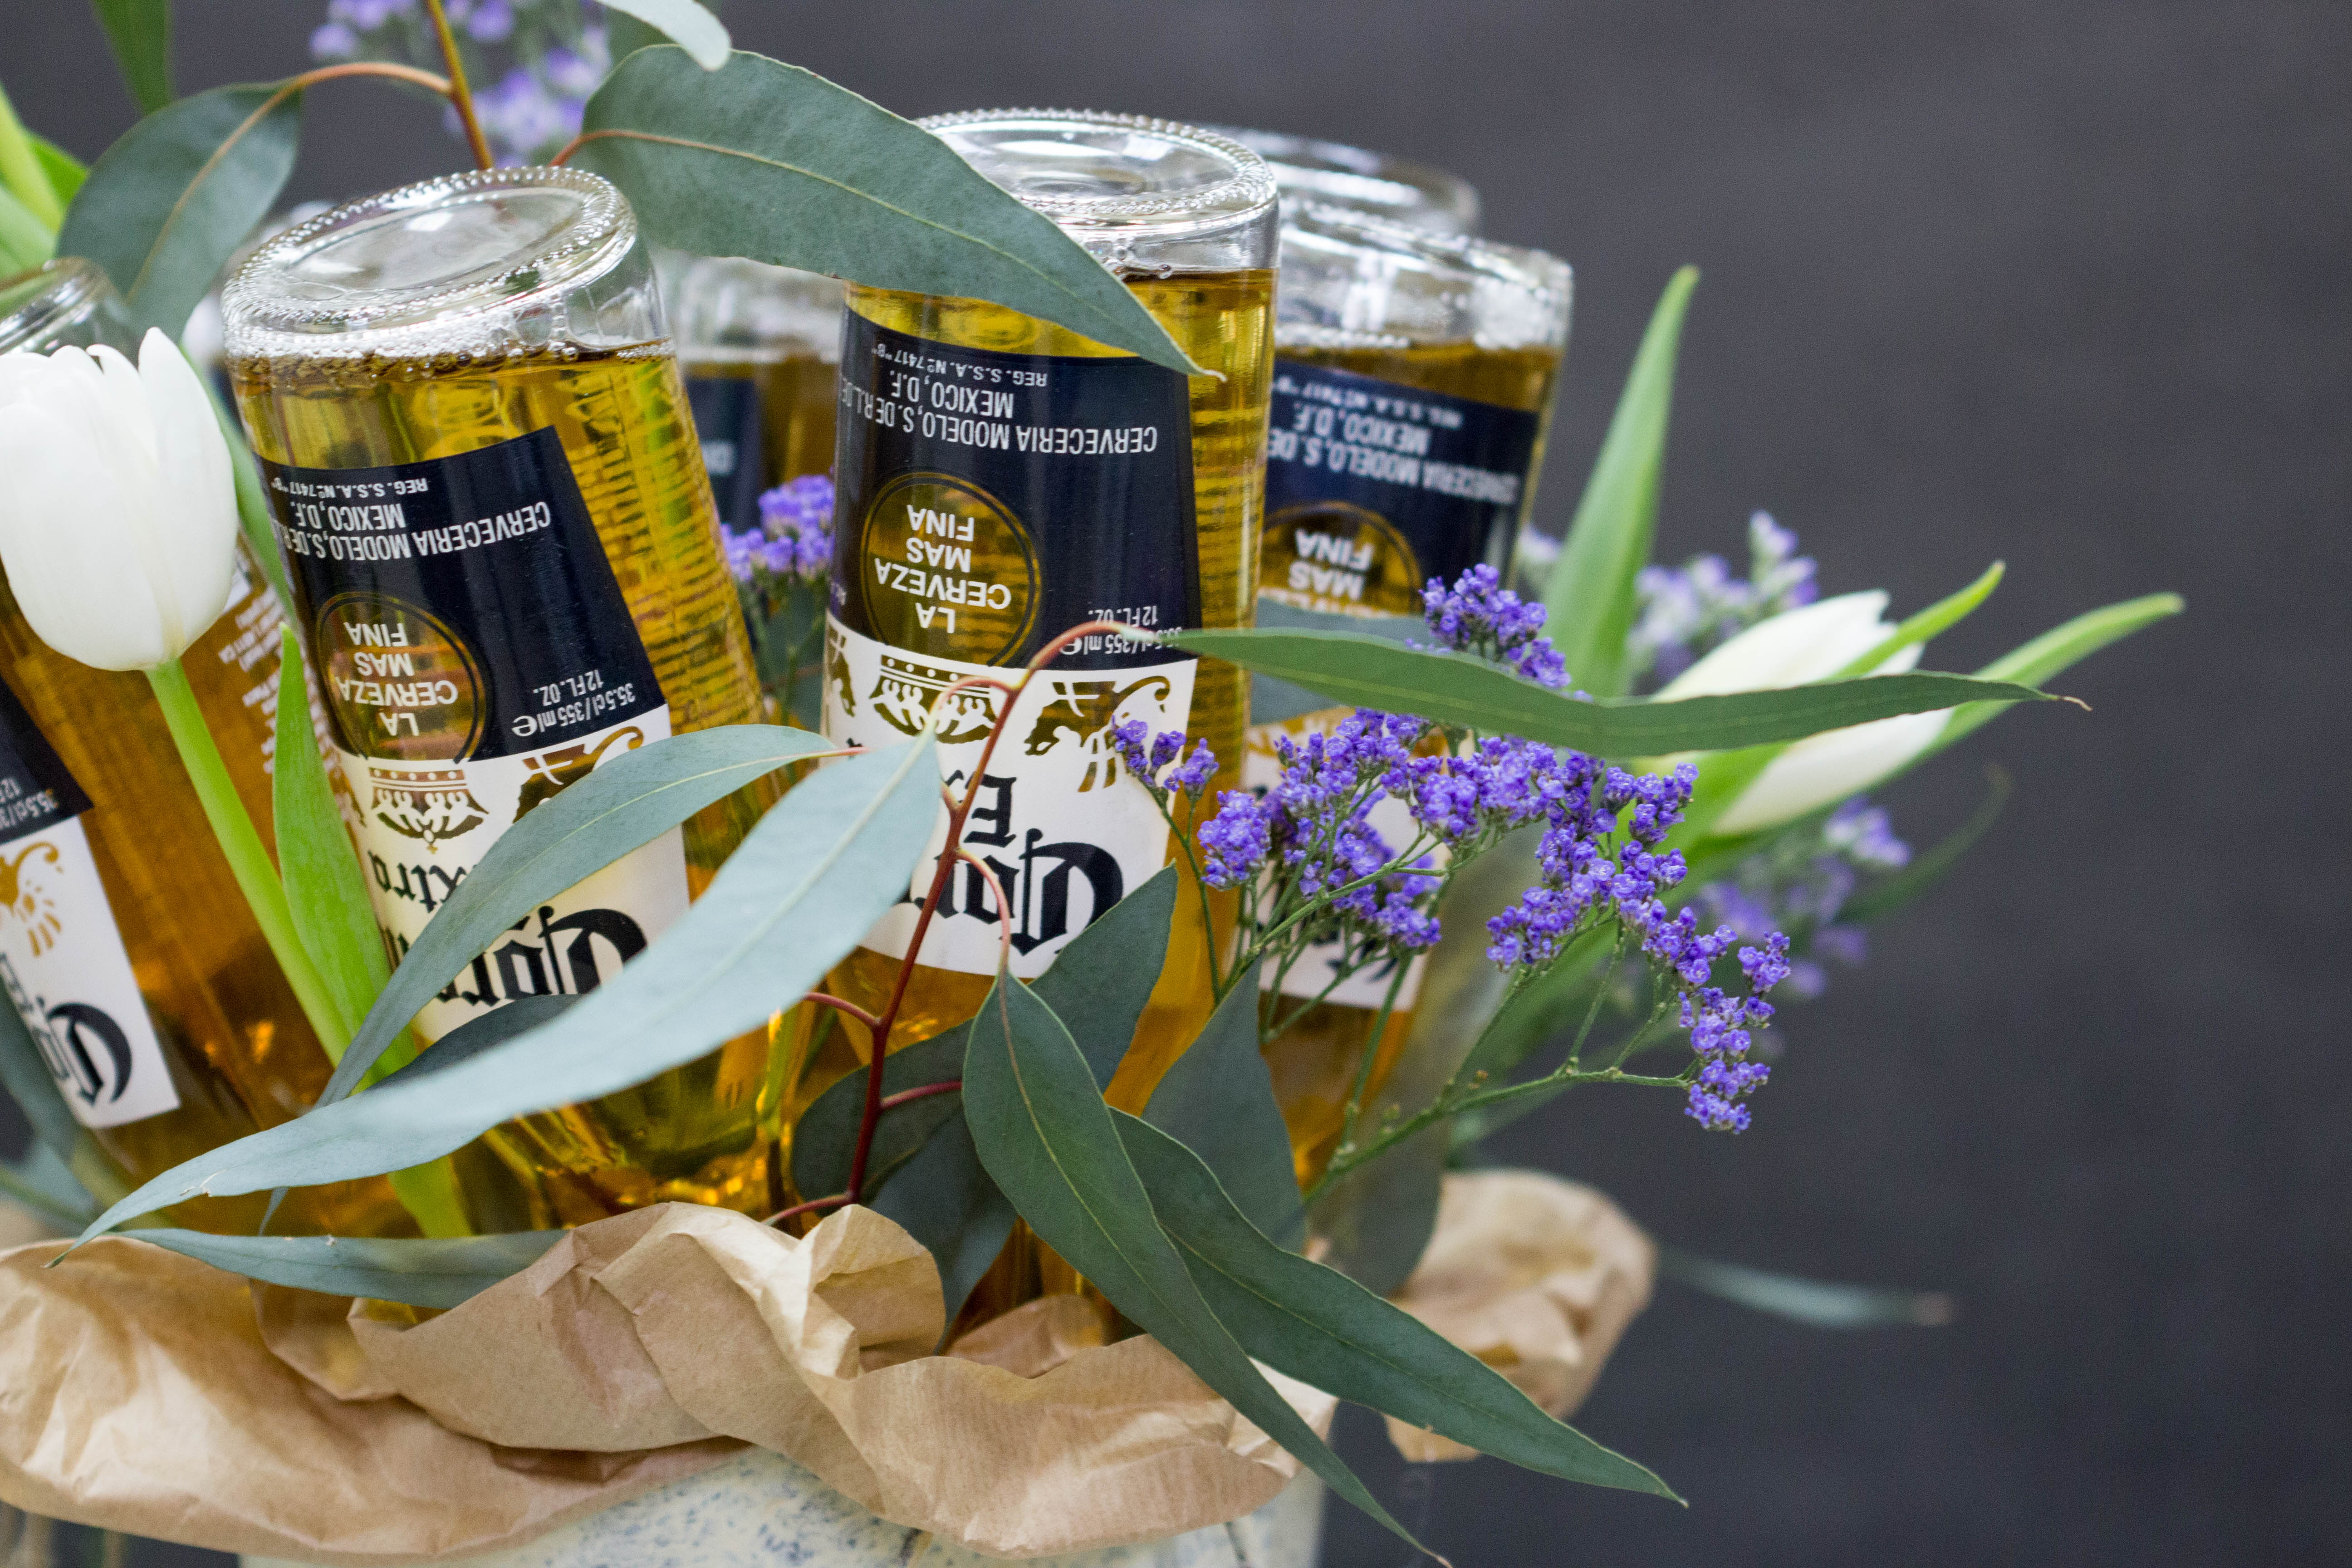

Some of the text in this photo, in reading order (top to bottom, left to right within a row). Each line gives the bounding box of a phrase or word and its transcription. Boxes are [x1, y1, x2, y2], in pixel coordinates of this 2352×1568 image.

[890, 370, 920, 402] D.F.
[950, 362, 1002, 383] S.S.A.
[1005, 371, 1048, 387] REG.
[1016, 426, 1158, 454] CERVECERIA
[336, 483, 385, 498] S.S.A.
[387, 478, 428, 495] REG.
[290, 501, 322, 529] D.F.
[411, 501, 551, 556] CERVECERIA
[906, 505, 975, 541] FINA
[906, 537, 971, 573] MAS
[1294, 527, 1374, 572] FINA
[874, 558, 1011, 609] CERVEZA
[1288, 560, 1366, 601] MAS
[915, 603, 956, 634] LA
[343, 622, 408, 647] FINA
[353, 652, 415, 677] MAS
[335, 676, 458, 707] CERVEZA
[533, 683, 561, 706] OZ.
[379, 712, 419, 736] LA
[368, 850, 474, 913] xtra
